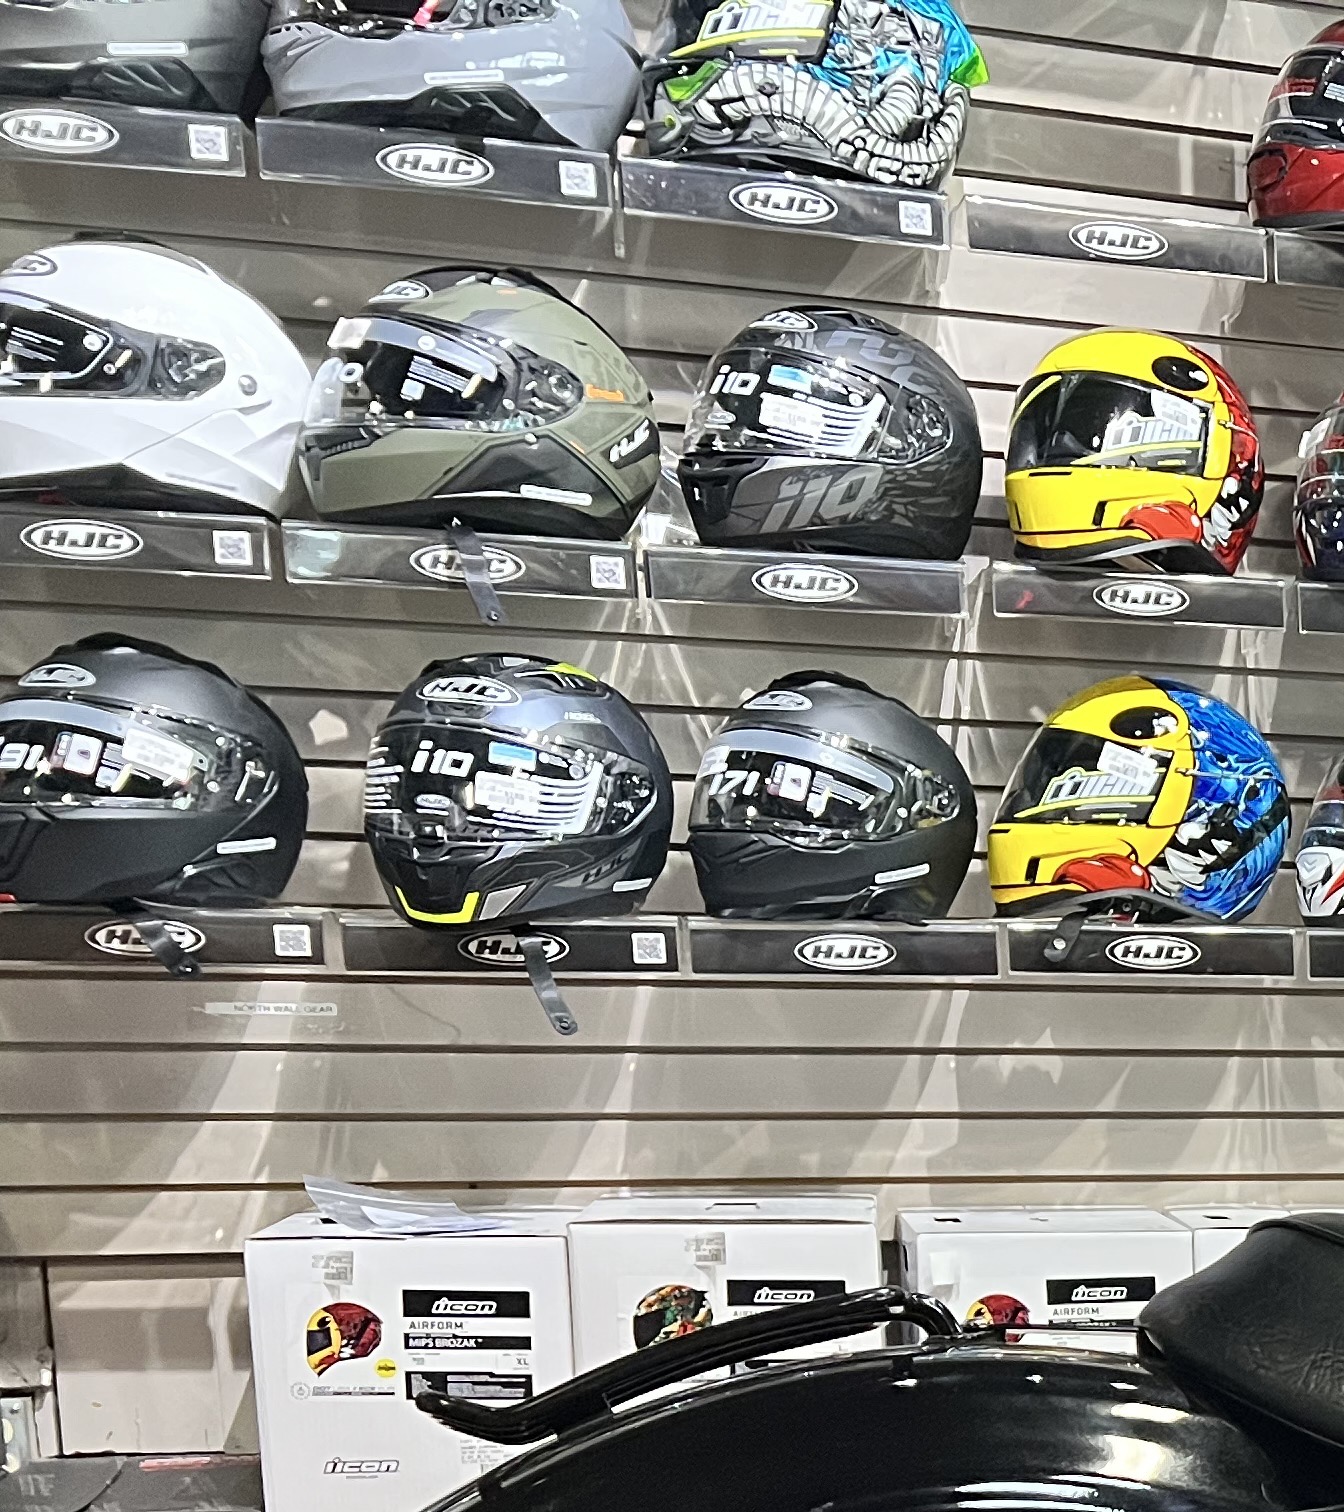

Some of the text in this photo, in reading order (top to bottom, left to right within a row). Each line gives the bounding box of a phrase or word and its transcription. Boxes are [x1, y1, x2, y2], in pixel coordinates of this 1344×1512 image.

[13, 118, 98, 143] HJC
[395, 153, 475, 177] HJC
[746, 190, 823, 215] HJC
[1084, 229, 1153, 250] HJC
[609, 417, 651, 463] HJC
[40, 529, 124, 550] HJC
[769, 573, 842, 592] HJC
[1106, 589, 1177, 609] HJC
[411, 739, 475, 777] i10
[811, 944, 882, 961] HJC
[1120, 944, 1187, 962] HJC
[1053, 1307, 1101, 1317] AIRFORM
[409, 1320, 464, 1330] AIRFORM
[408, 1338, 434, 1348] MIPS
[516, 1357, 529, 1366] XL
